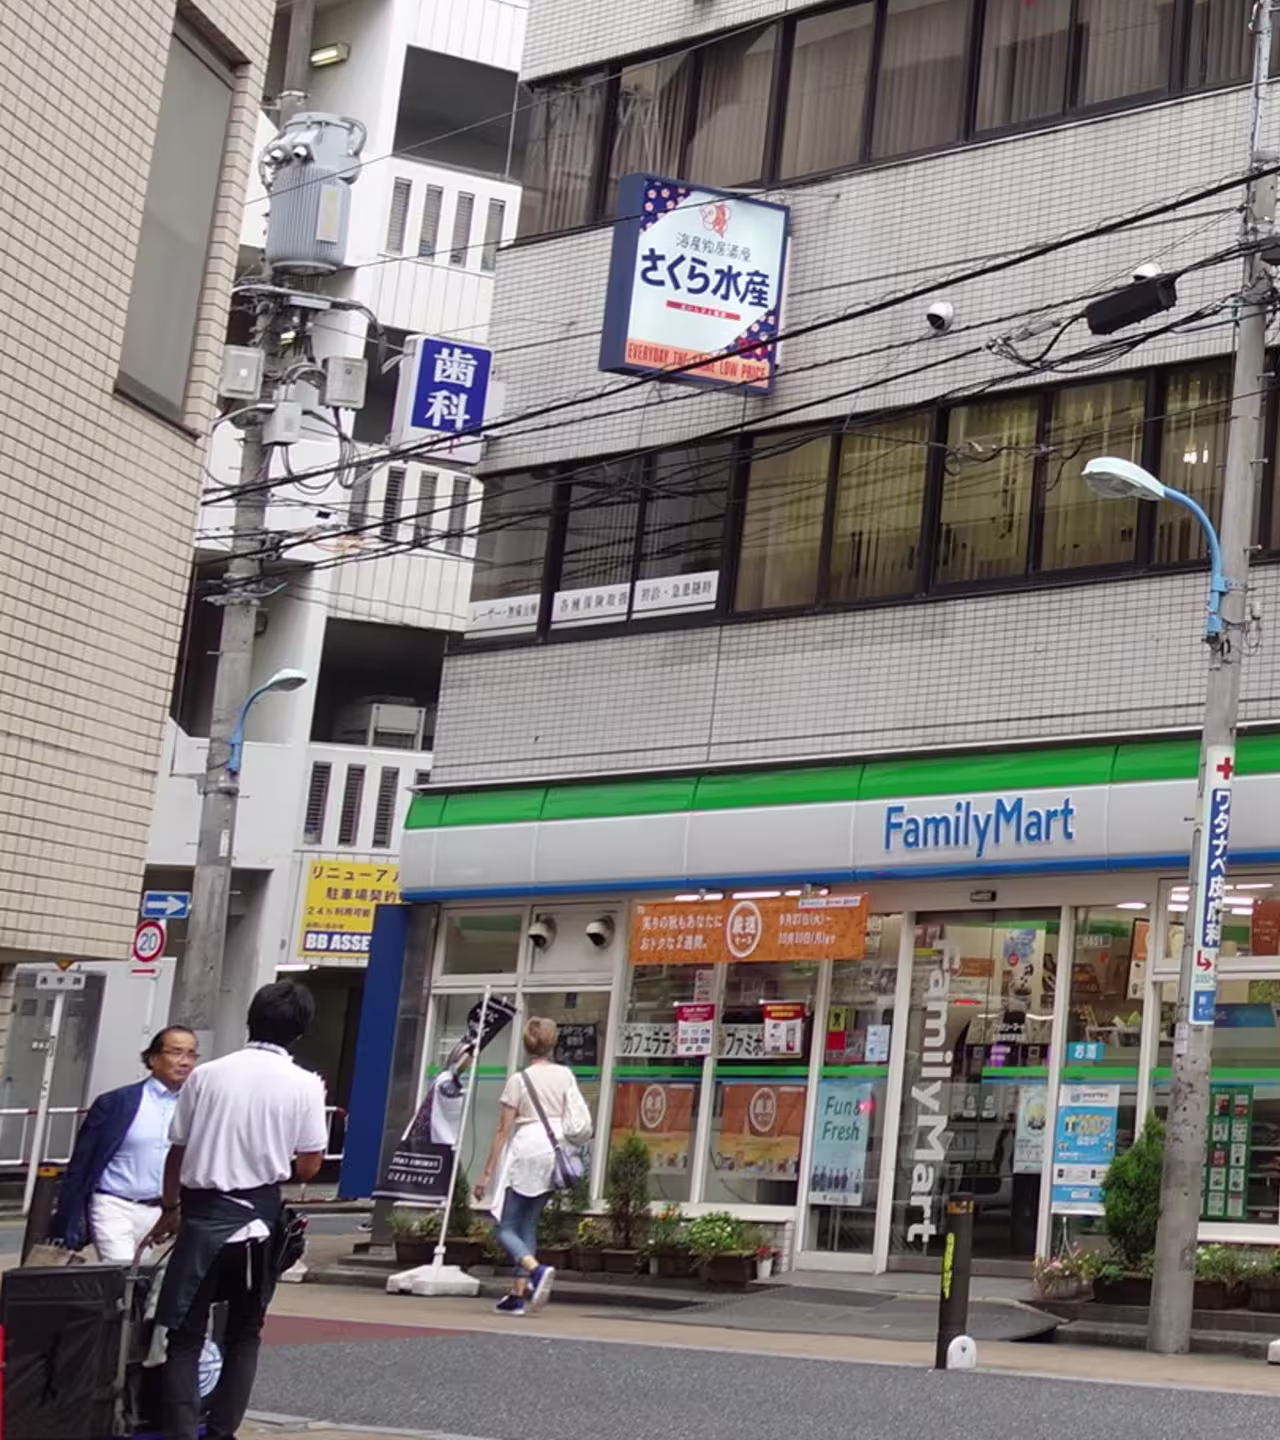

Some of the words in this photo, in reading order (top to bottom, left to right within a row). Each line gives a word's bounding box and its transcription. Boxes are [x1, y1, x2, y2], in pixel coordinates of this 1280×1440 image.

[640, 248, 770, 308] さくら水産
[628, 343, 669, 362] EVERYDAY
[425, 347, 478, 431] 歯科
[885, 797, 1074, 858] FamilyMart
[1205, 791, 1231, 946] ワタナベ皮膚科
[139, 932, 157, 951] 20
[305, 933, 329, 949] BB
[908, 939, 960, 1243] FamilyMart
[822, 1121, 859, 1140] Fresh
